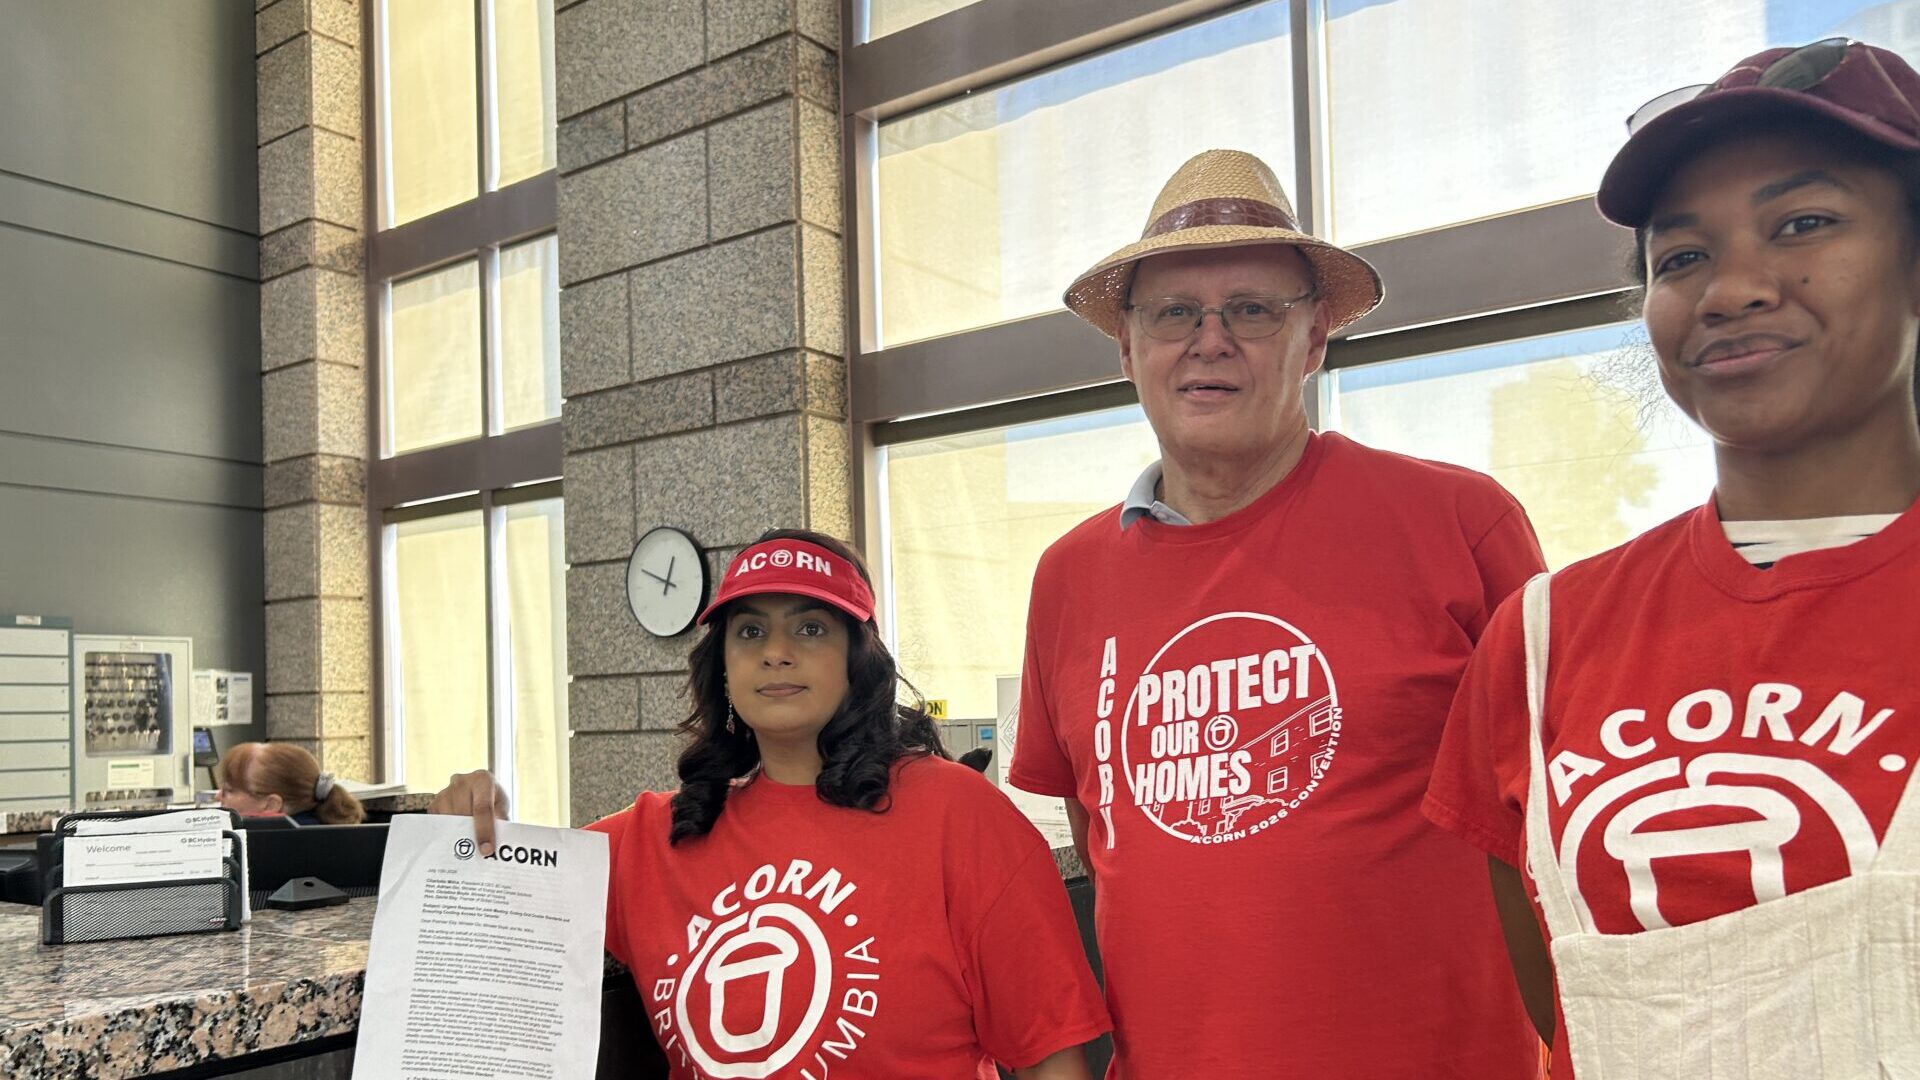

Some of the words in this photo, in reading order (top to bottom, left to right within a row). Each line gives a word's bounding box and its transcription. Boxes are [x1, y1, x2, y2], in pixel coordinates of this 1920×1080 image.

[1137, 643, 1317, 727] PROTECT
[1134, 750, 1252, 807] HOMES
[1150, 720, 1199, 759] OUR
[1190, 830, 1247, 845] ACORN
[1249, 808, 1288, 835] 2026
[1289, 707, 1343, 809] CONVENTION
[1548, 682, 1895, 807] ACORN
[86, 844, 131, 854] Welcome
[686, 859, 857, 953] ACORN
